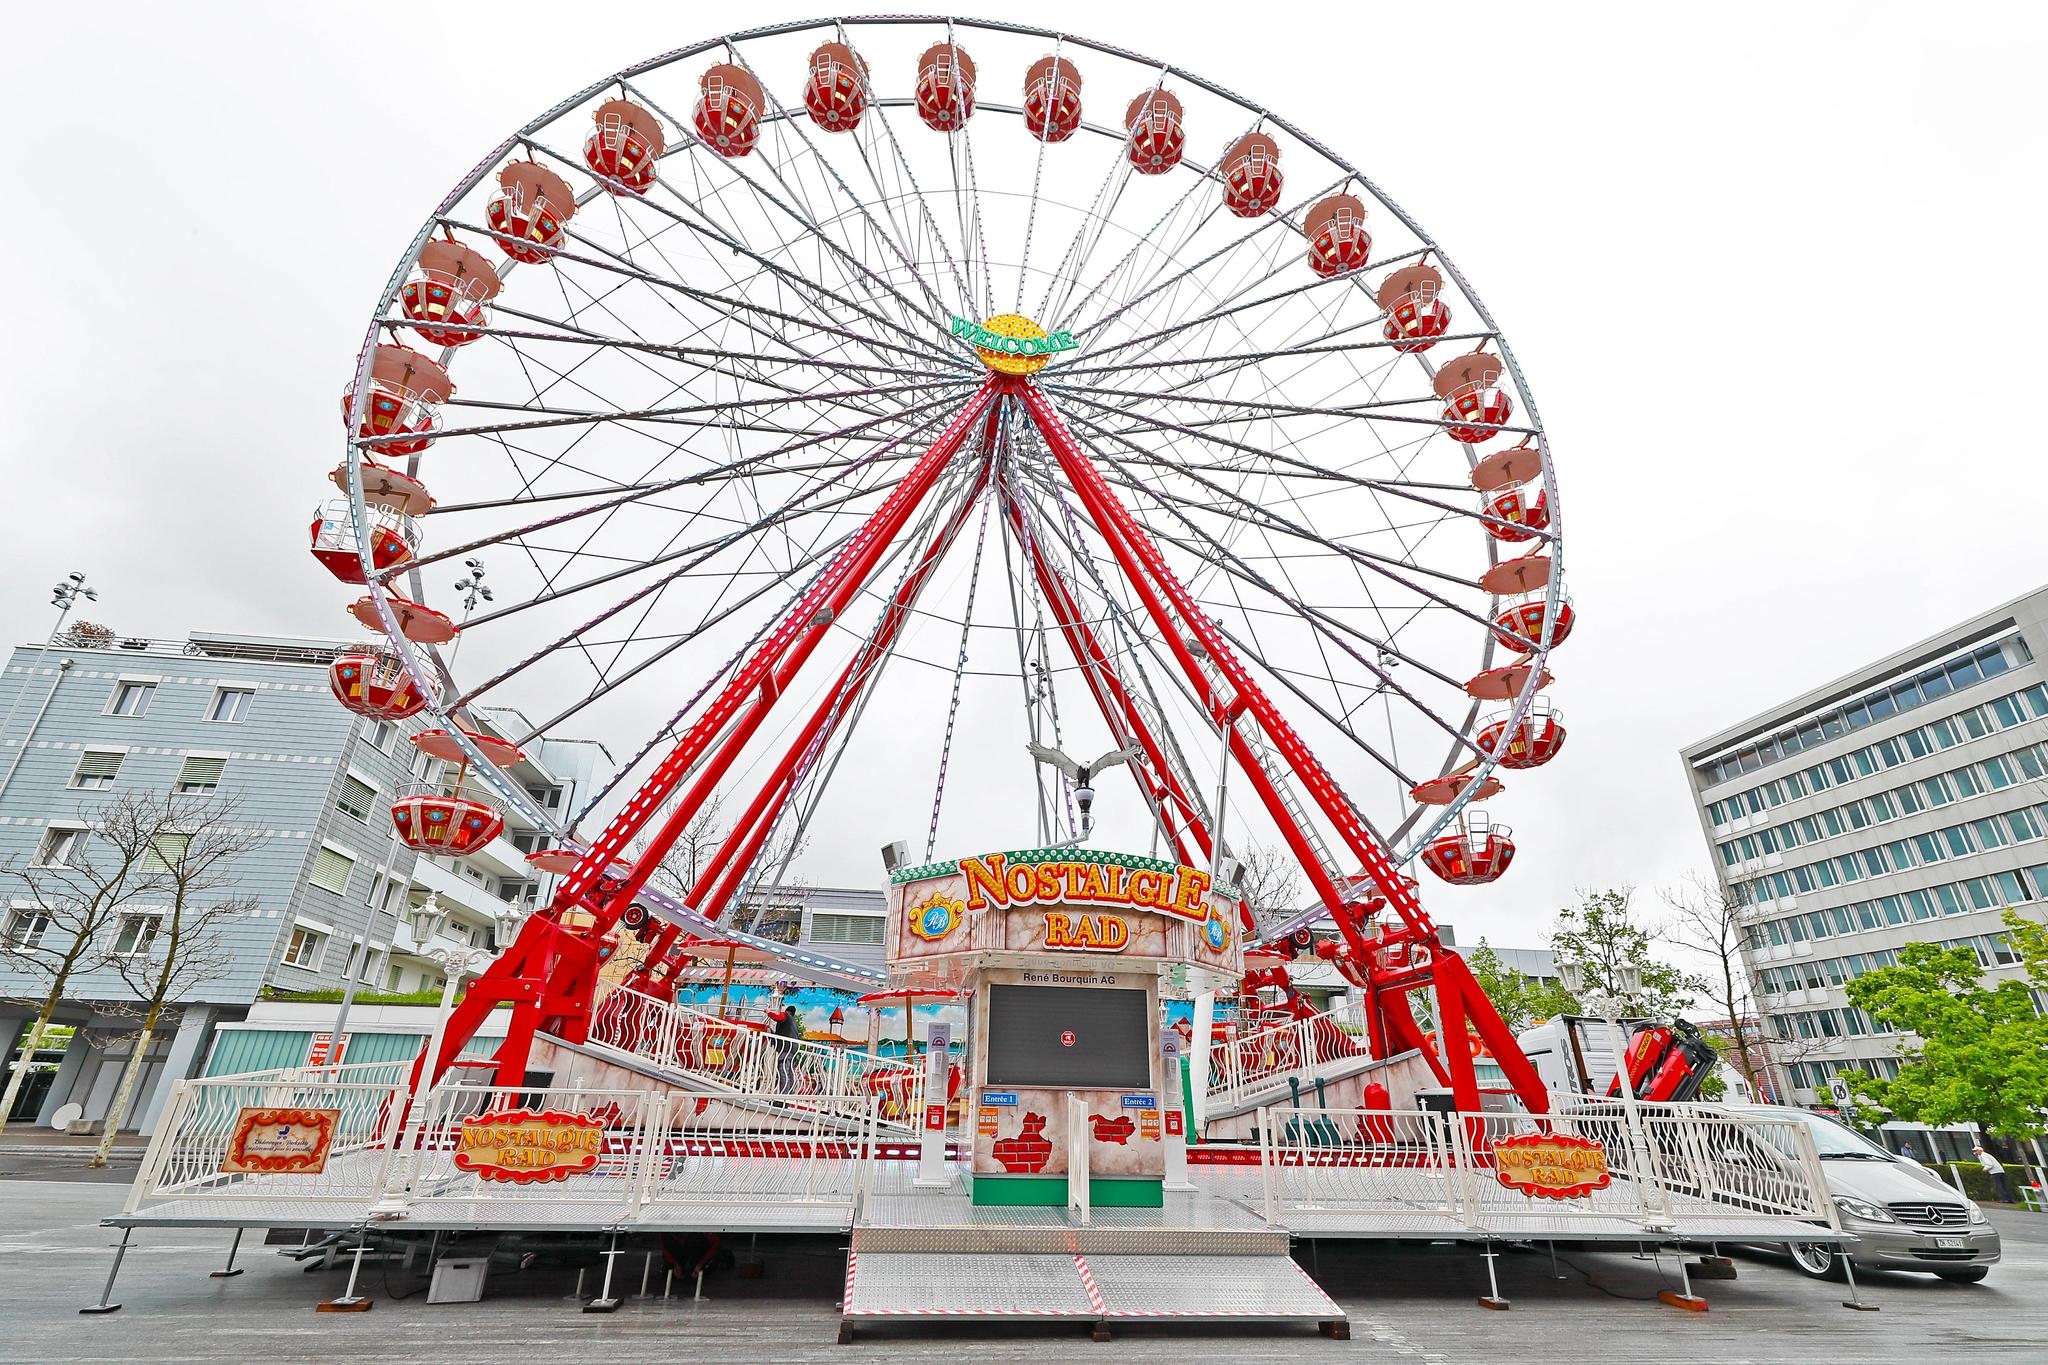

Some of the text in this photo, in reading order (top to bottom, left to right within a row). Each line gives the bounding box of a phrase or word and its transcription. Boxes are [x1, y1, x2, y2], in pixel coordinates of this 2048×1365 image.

[951, 315, 1079, 355] WELCOME
[960, 854, 1211, 922] NOSTALGIE
[1044, 913, 1129, 949] RAD
[1023, 972, 1116, 985] René Bourquin AG
[984, 1095, 1013, 1103] Entrée 1
[1124, 1097, 1153, 1106] Entrée 2
[458, 1126, 603, 1153] NOSTALGIE
[495, 1147, 558, 1167] RAD
[1495, 1147, 1608, 1173] NOSTALGIE
[1530, 1167, 1579, 1185] RAD
